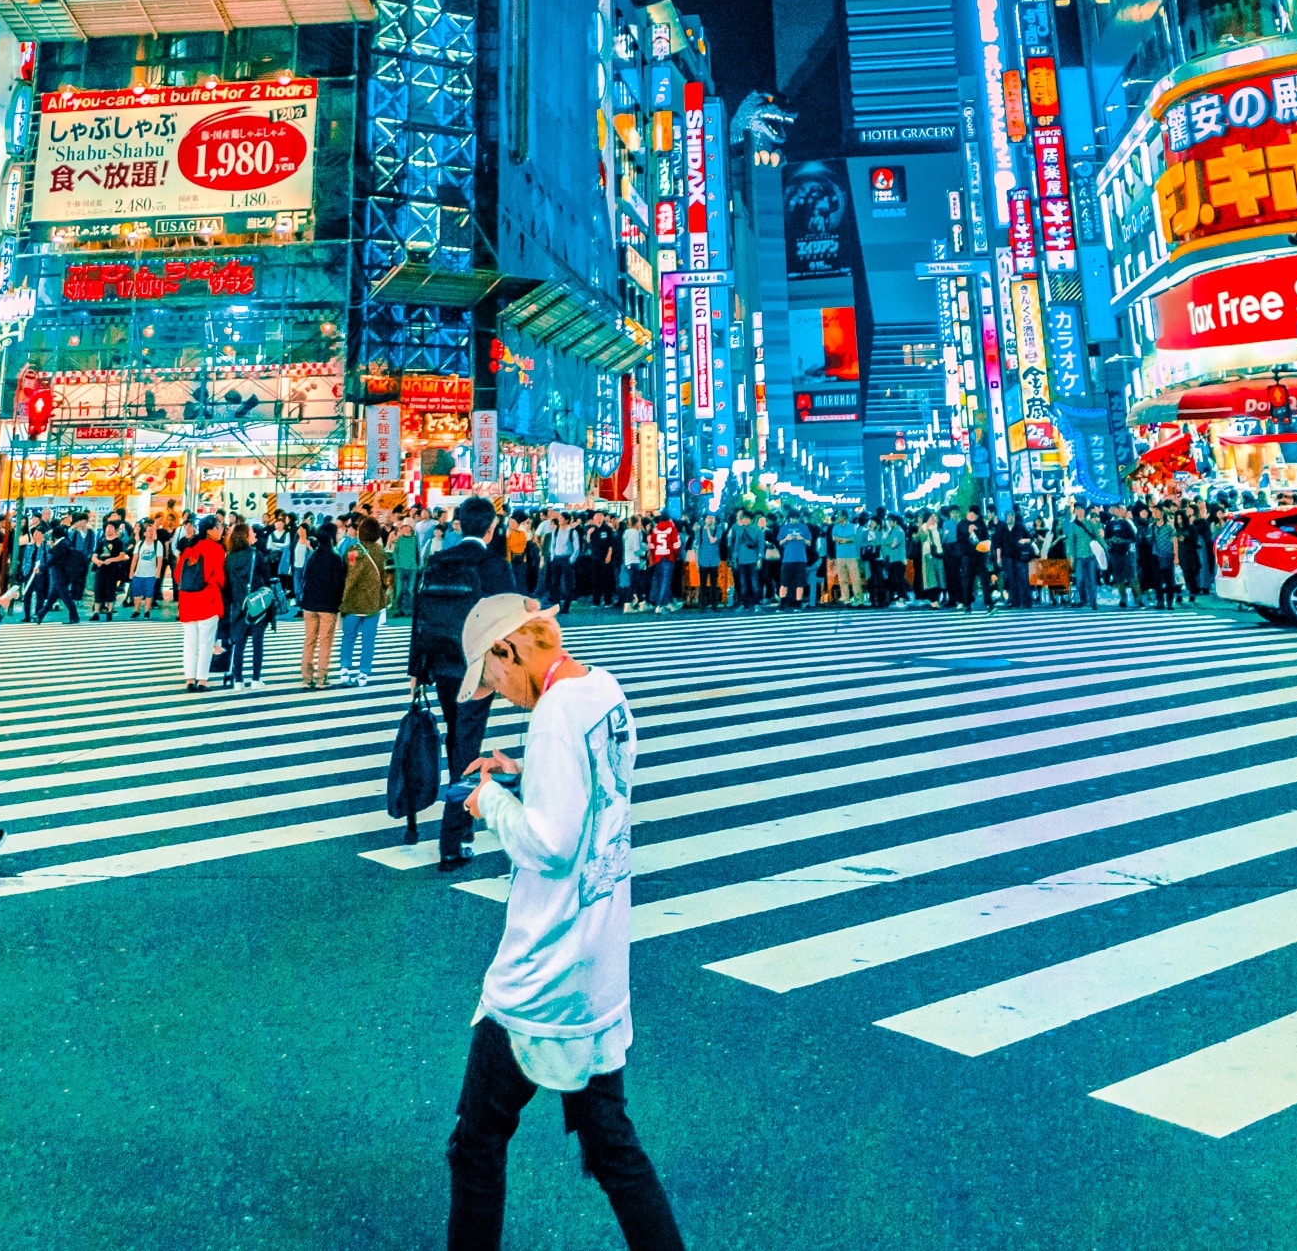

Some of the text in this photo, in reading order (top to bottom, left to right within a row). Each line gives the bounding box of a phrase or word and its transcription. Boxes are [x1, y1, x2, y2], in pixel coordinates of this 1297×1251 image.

[224, 85, 244, 99] for
[251, 84, 262, 97] 2
[265, 82, 313, 98] hours
[50, 112, 178, 143] しゃぶしゃぶ
[862, 126, 955, 141] HOTEL GRACERY
[195, 141, 295, 183] 1,980 yen
[687, 110, 706, 205] SHIDAX
[114, 197, 152, 215] 2,480
[230, 193, 266, 209] 1,480
[276, 211, 307, 231] 5F
[1188, 300, 1216, 335] Tax
[1218, 290, 1285, 327] Free
[1055, 311, 1080, 390] カラオケ
[378, 408, 390, 476] 全館営業中
[480, 413, 493, 479] 全館営業中
